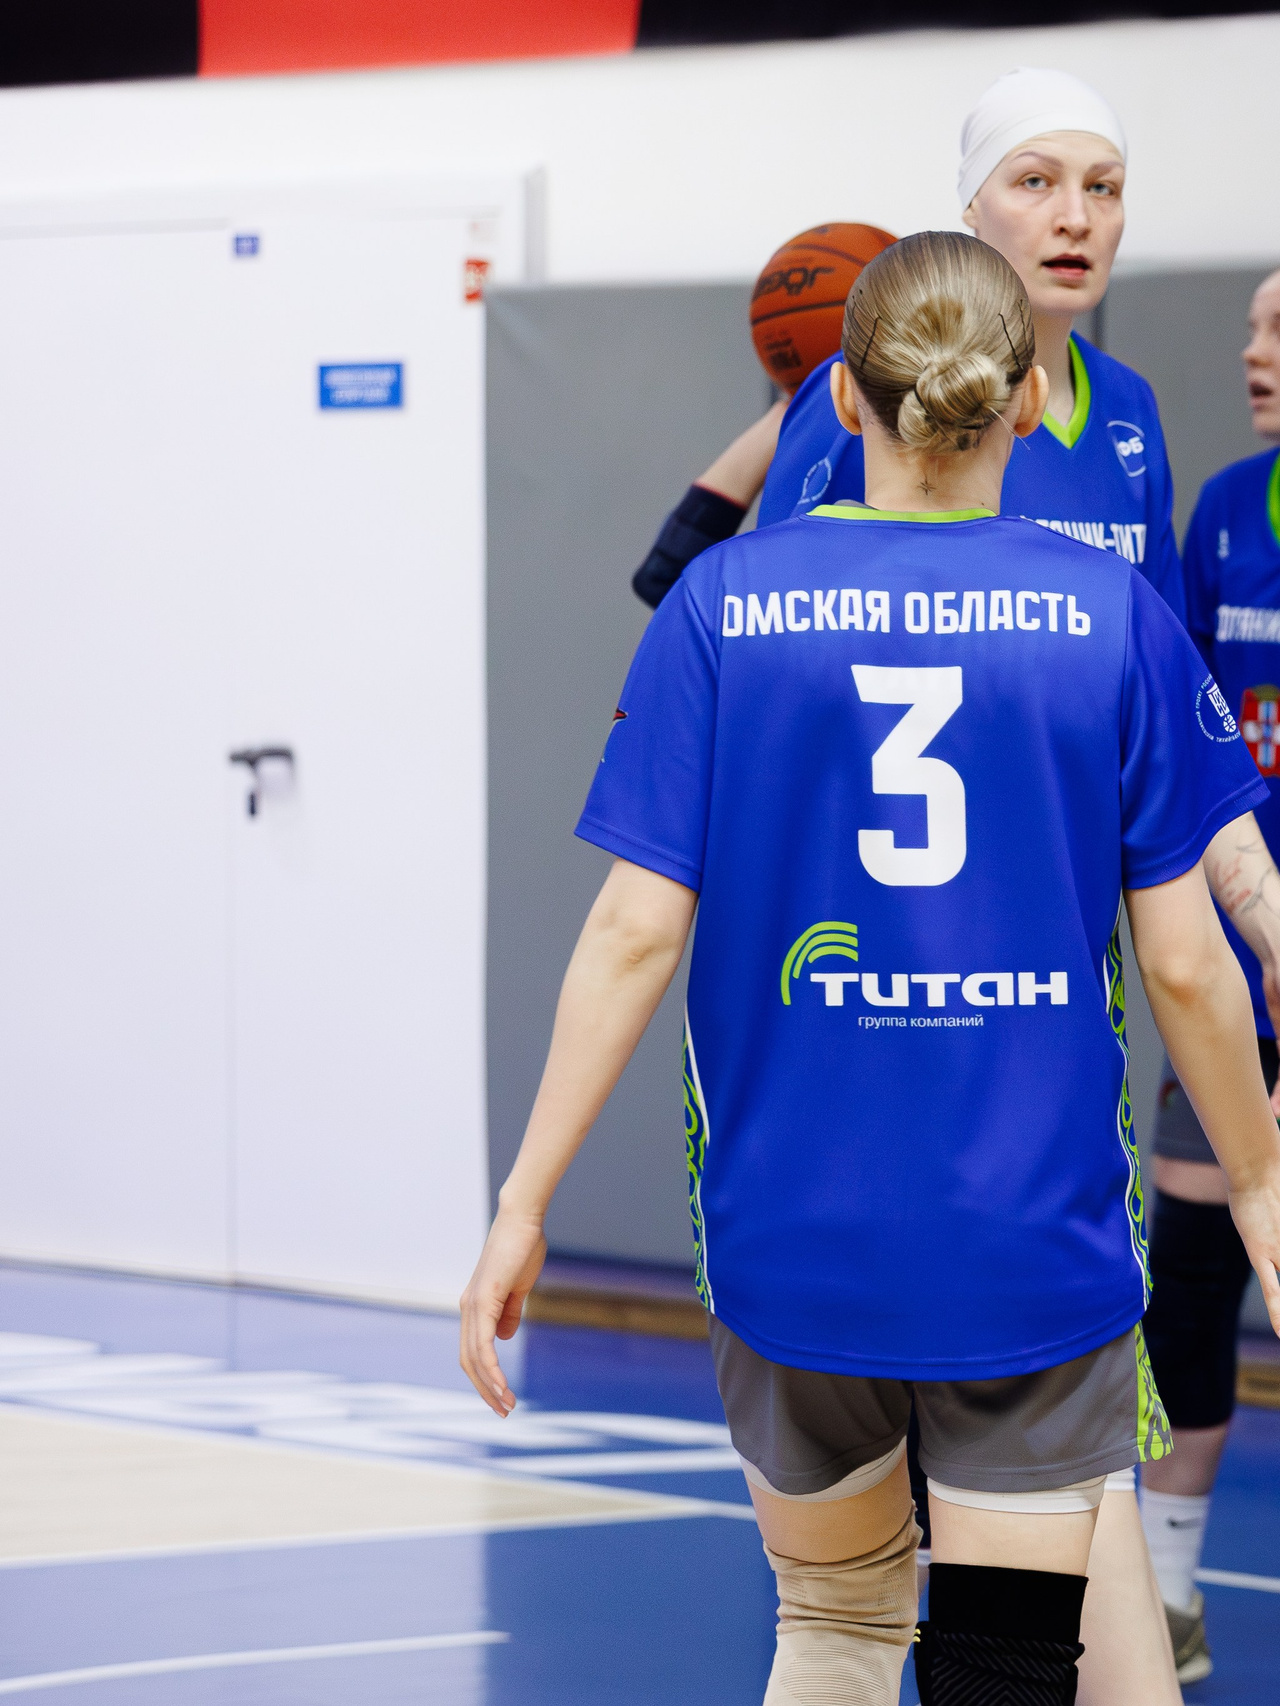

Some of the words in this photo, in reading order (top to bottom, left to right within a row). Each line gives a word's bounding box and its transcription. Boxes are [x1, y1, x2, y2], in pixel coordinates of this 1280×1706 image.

[722, 588, 891, 637] ОМСКАЯ
[904, 589, 1091, 636] ОБЛАСТЬ
[850, 664, 967, 887] 3
[858, 1016, 908, 1029] группа
[910, 1014, 985, 1028] компаний
